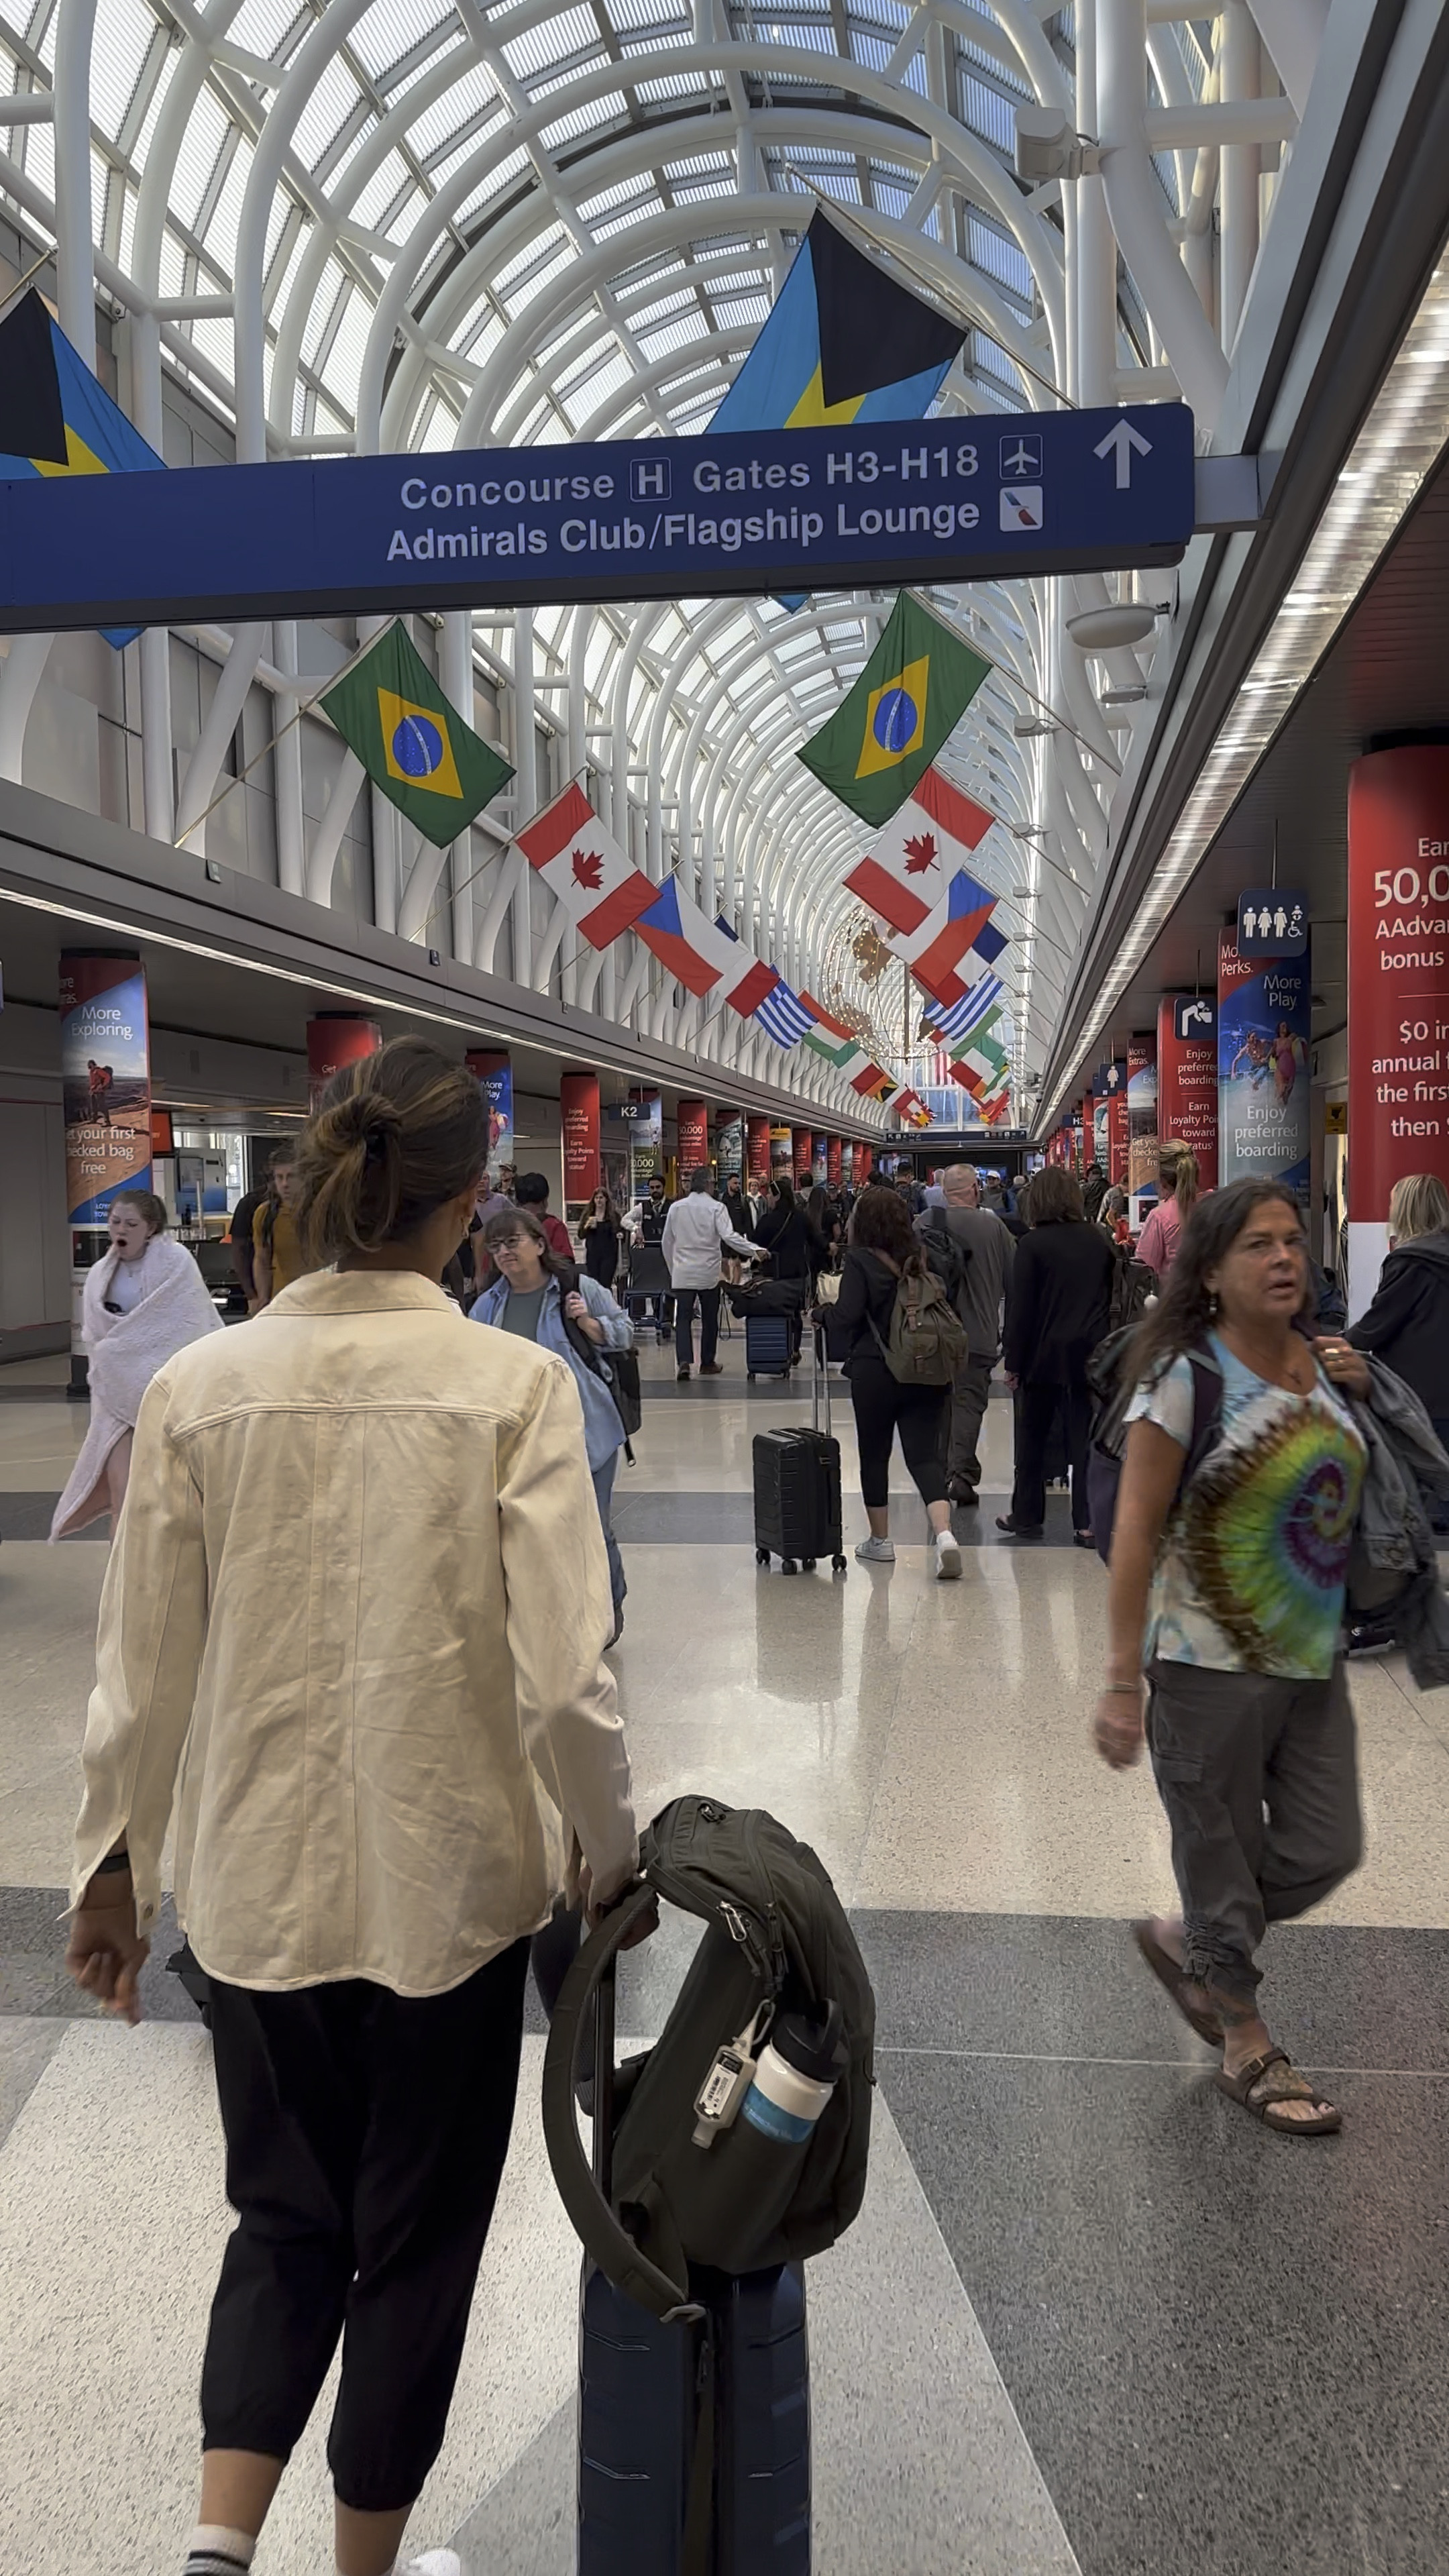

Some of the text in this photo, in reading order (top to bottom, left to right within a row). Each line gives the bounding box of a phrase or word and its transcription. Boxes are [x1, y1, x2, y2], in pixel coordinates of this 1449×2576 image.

[400, 444, 979, 511] Concourse H Gates H3-H18
[386, 501, 980, 562] Admirals Club/Flagship Lounge
[1375, 915, 1449, 940] AAdva
[1221, 945, 1240, 959] Mo
[1381, 950, 1444, 971] bonus
[1263, 975, 1302, 989] More
[82, 1006, 121, 1020] More
[1399, 1020, 1429, 1044] $0
[1186, 1049, 1212, 1061] Enjoy
[1371, 1050, 1440, 1073] annual
[1377, 1083, 1409, 1104] the
[621, 1106, 638, 1117] K2
[1188, 1102, 1210, 1111] Earn
[1246, 1105, 1287, 1123] Enjoy
[1170, 1115, 1201, 1127] Loyalty
[1391, 1116, 1440, 1136] then
[77, 1129, 107, 1143] your
[109, 1126, 136, 1139] first
[1183, 1128, 1215, 1137] toward
[1234, 1123, 1298, 1142] preferred
[109, 1143, 134, 1161] bag
[1133, 1148, 1159, 1157] checke
[1236, 1142, 1297, 1160] boarding
[80, 1161, 106, 1174] free
[1147, 1158, 1158, 1166] fre
